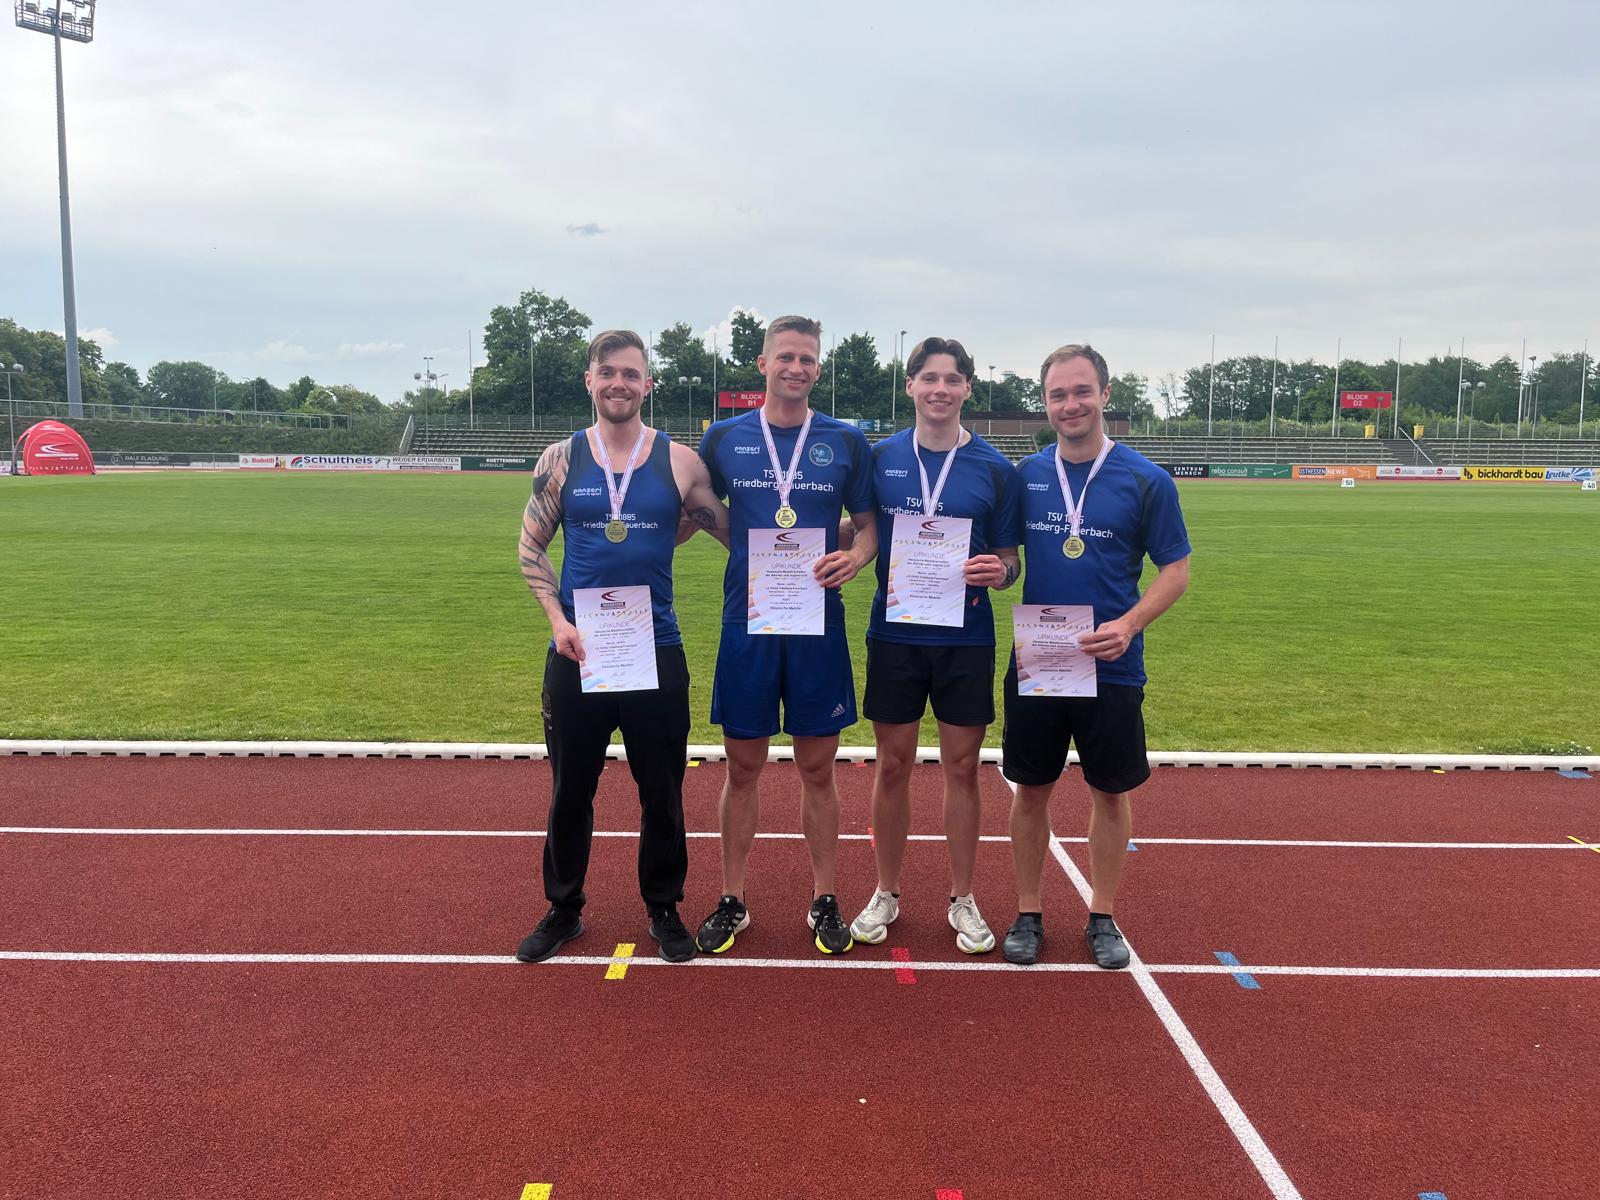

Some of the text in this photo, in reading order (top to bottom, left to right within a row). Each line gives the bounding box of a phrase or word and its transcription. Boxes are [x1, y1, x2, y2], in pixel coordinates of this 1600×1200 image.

[303, 456, 373, 464] Schultheis
[1211, 466, 1226, 474] rebo
[1226, 466, 1248, 474] consult
[1477, 468, 1544, 479] bickhardt bau
[733, 478, 834, 493] Friedberguerbach
[906, 496, 923, 508] TSV
[1047, 511, 1084, 525] TSV 15
[1025, 520, 1113, 538] Friedberg-Ferbach
